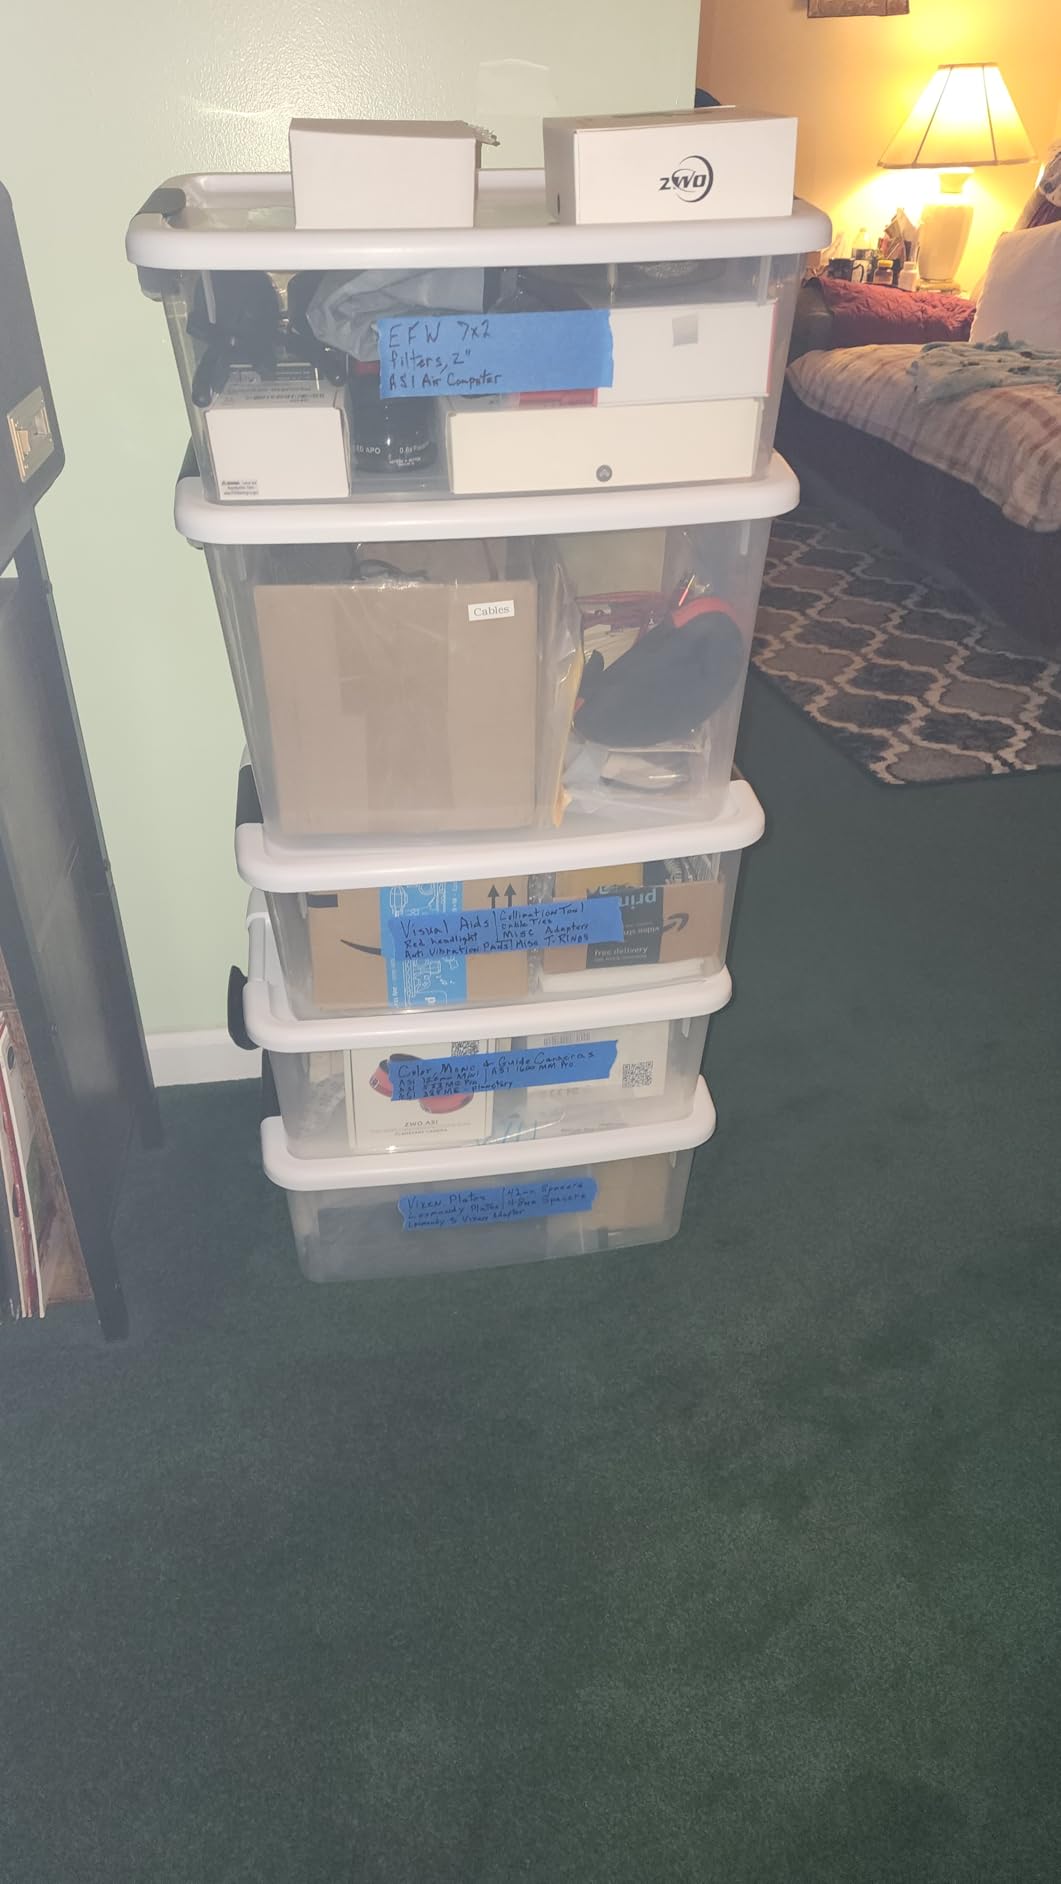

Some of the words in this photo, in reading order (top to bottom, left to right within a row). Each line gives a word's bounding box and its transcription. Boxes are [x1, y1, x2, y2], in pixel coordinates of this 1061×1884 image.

[457, 319, 490, 341] 7x2
[422, 373, 441, 388] Air
[447, 368, 502, 390] Computer
[473, 605, 510, 617] Cables
[558, 903, 584, 914] Tool
[401, 919, 448, 939] Visual
[460, 915, 489, 931] Aids
[404, 939, 425, 949] Red
[613, 946, 648, 957] delivery
[404, 1120, 423, 1128] ZWO
